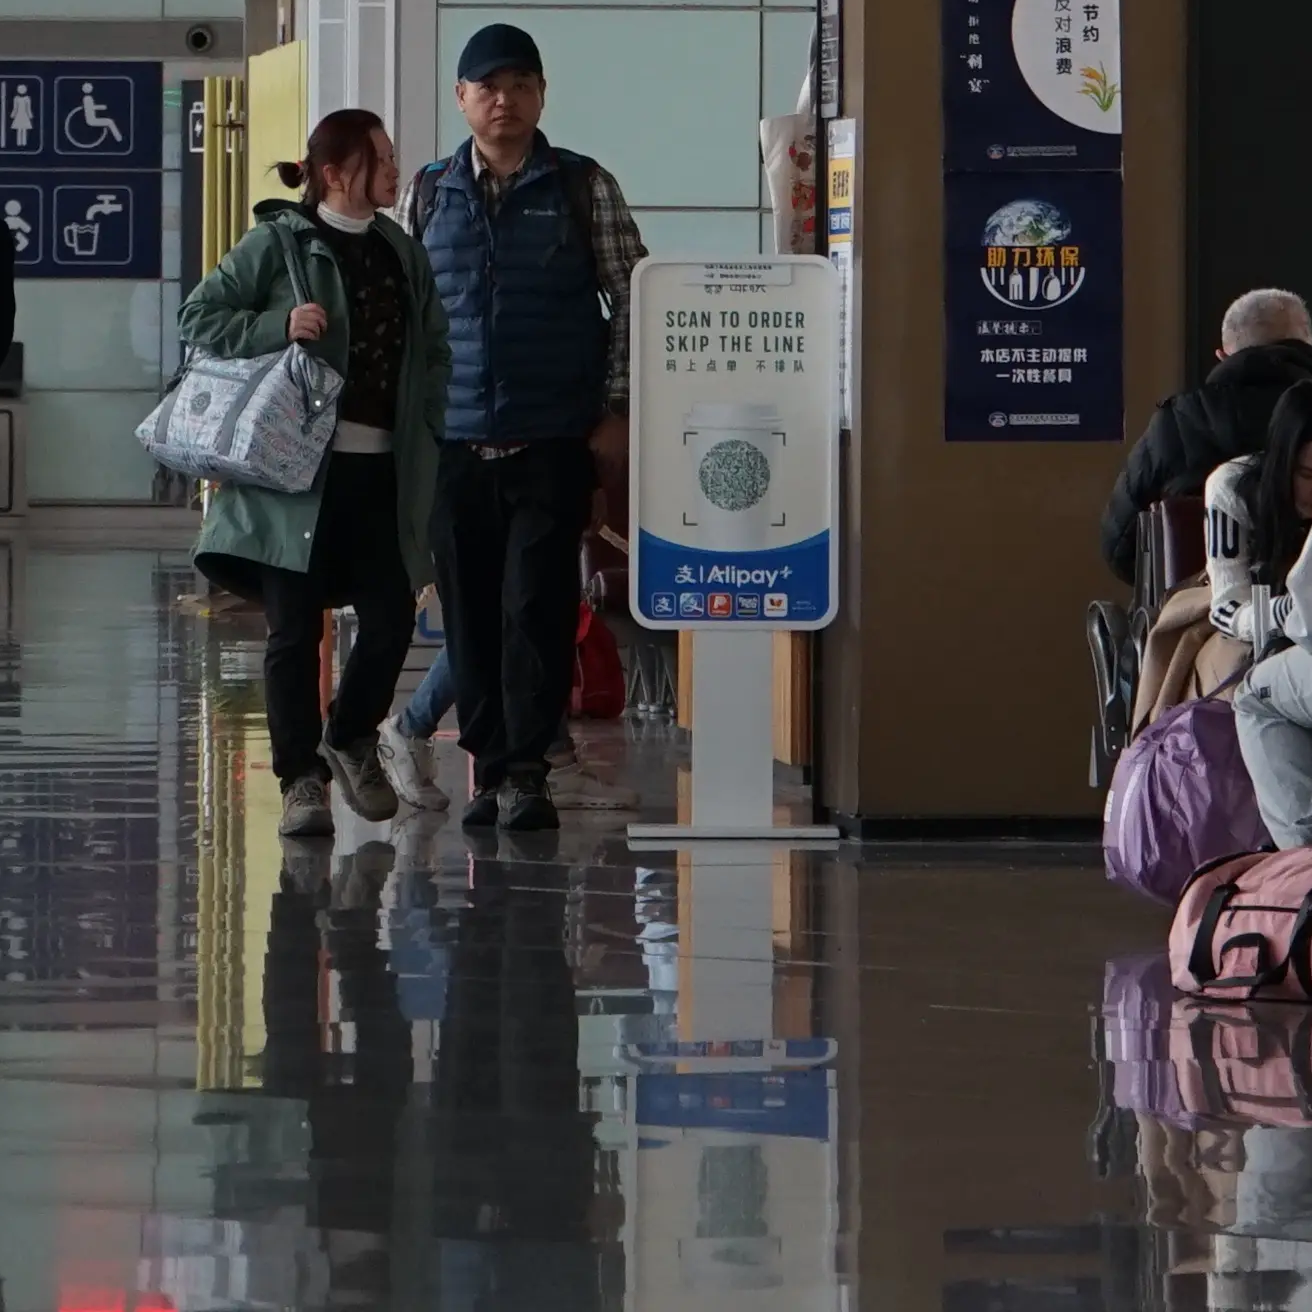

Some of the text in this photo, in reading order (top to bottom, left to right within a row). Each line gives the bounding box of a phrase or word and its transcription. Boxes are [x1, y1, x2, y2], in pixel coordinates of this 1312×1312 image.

[987, 245, 1081, 268] 助力环保
[665, 310, 805, 329] SCAN TO ORDER
[665, 335, 805, 353] SKIP THE LINE
[980, 348, 1088, 364] 本店不主动提供
[665, 359, 804, 373] 码上点单 不排队
[996, 368, 1073, 384] 一次性餐具
